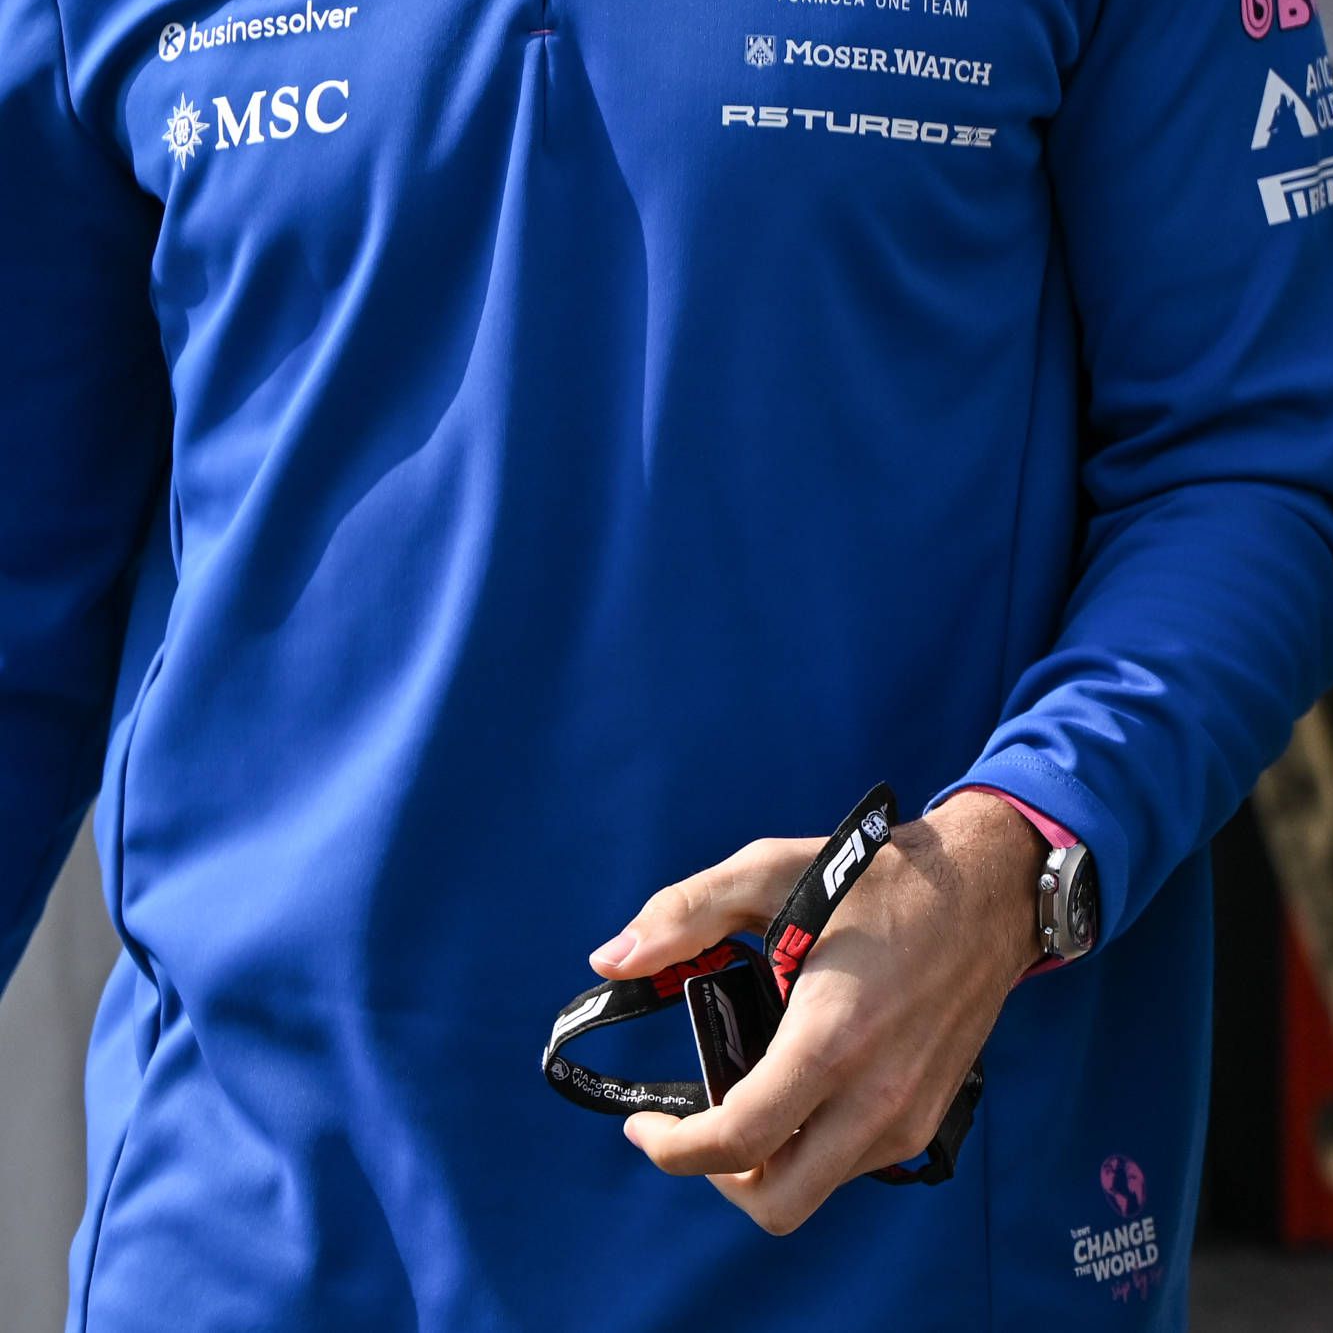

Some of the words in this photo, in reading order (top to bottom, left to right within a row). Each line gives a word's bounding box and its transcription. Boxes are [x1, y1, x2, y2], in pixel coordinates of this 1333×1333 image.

[189, 0, 358, 53] businessolver
[783, 38, 993, 87] MOSER.WATCH
[212, 79, 350, 151] MSC
[572, 1067, 589, 1081] FIA
[589, 1078, 638, 1097] Formula
[572, 1075, 602, 1098] World
[1073, 1216, 1156, 1264] CHANGE
[1074, 1265, 1092, 1277] THE
[1092, 1243, 1159, 1283] WORLD
